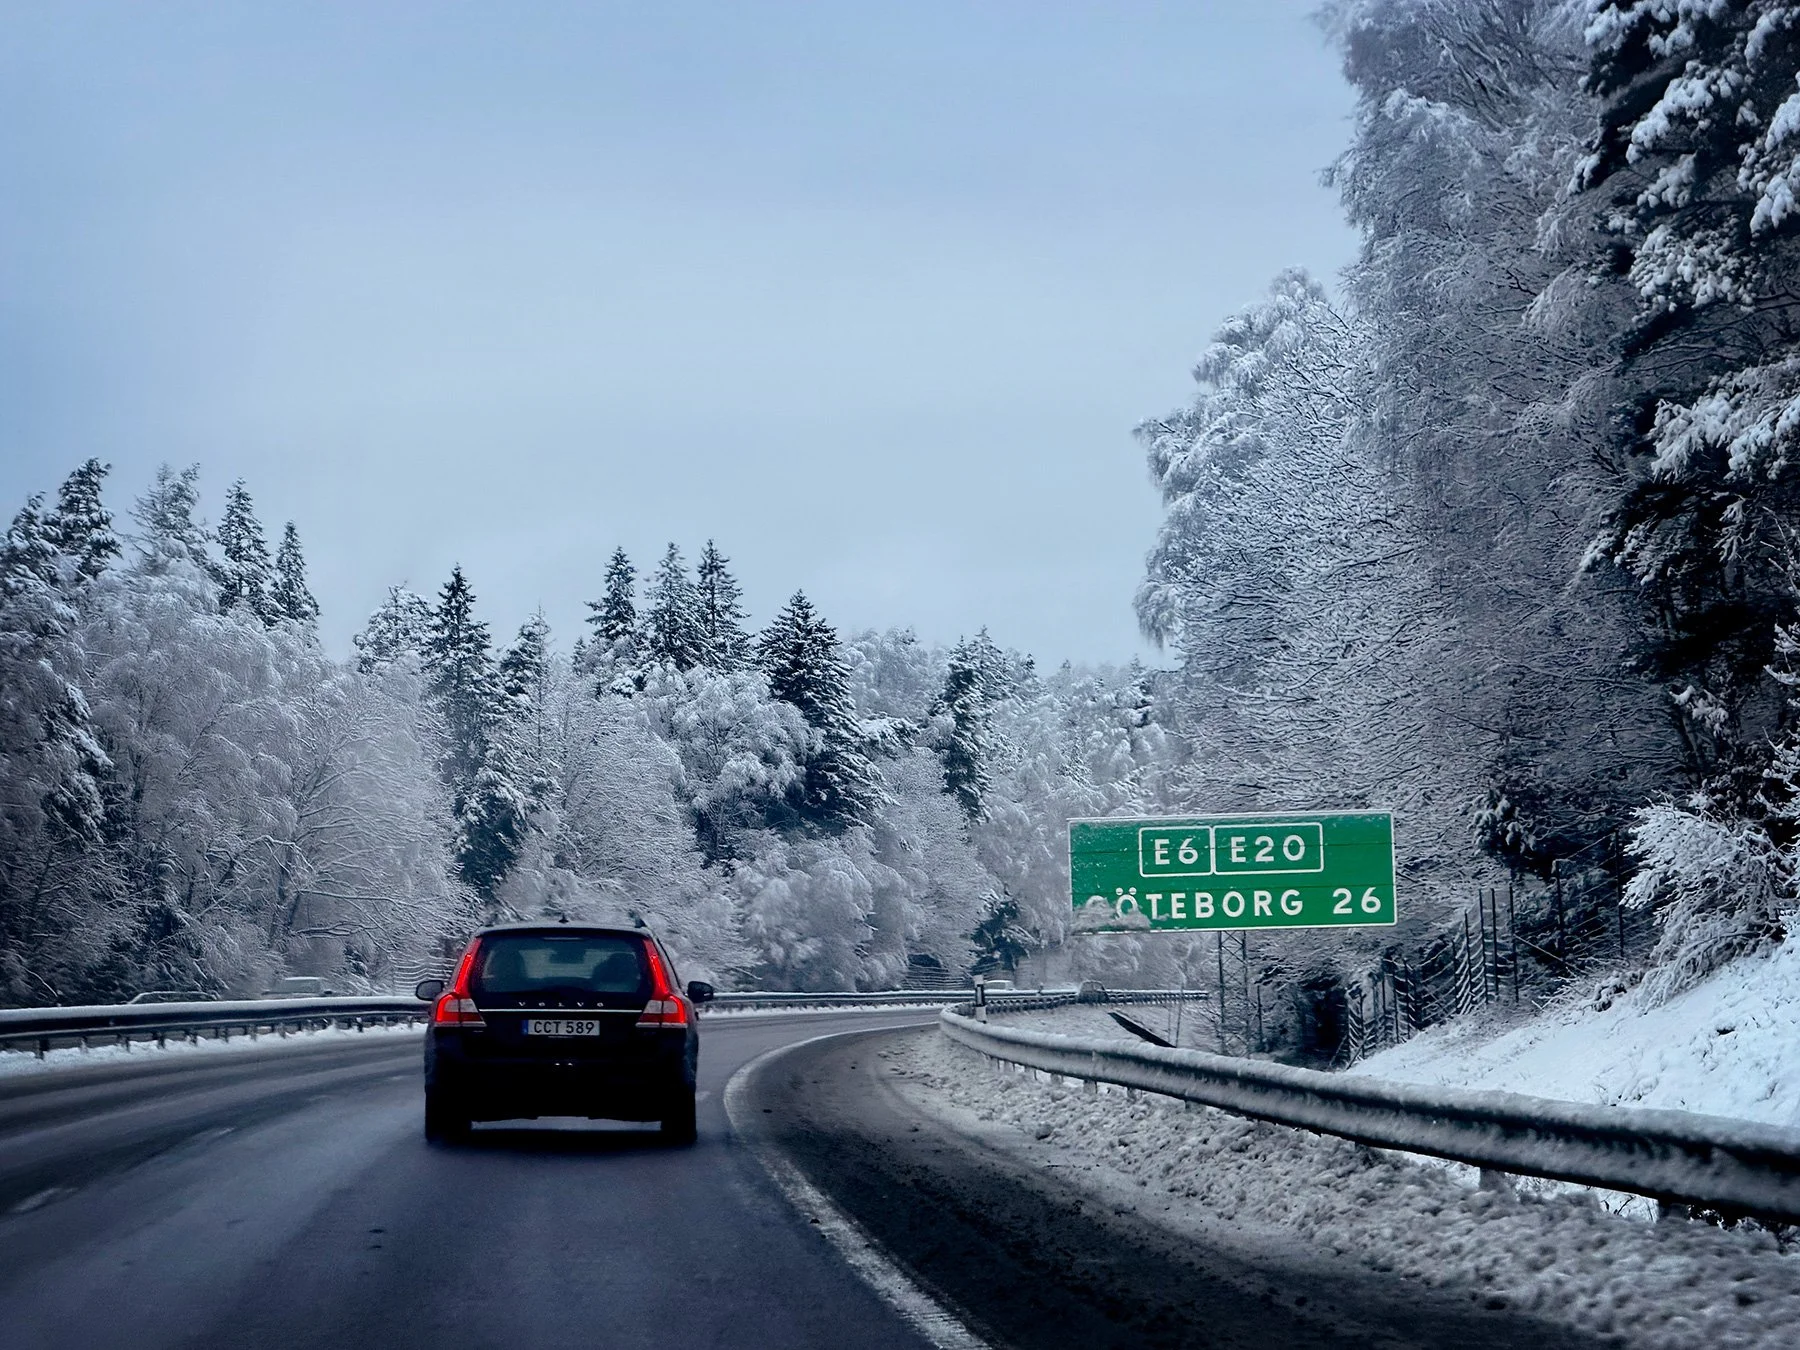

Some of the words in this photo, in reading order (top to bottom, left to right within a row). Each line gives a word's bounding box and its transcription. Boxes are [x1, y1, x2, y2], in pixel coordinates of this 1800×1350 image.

[1154, 838, 1199, 865] E6
[1231, 834, 1305, 863] E20
[1332, 887, 1382, 914] 26
[534, 1021, 561, 1033] CCT
[566, 1021, 595, 1034] 589
